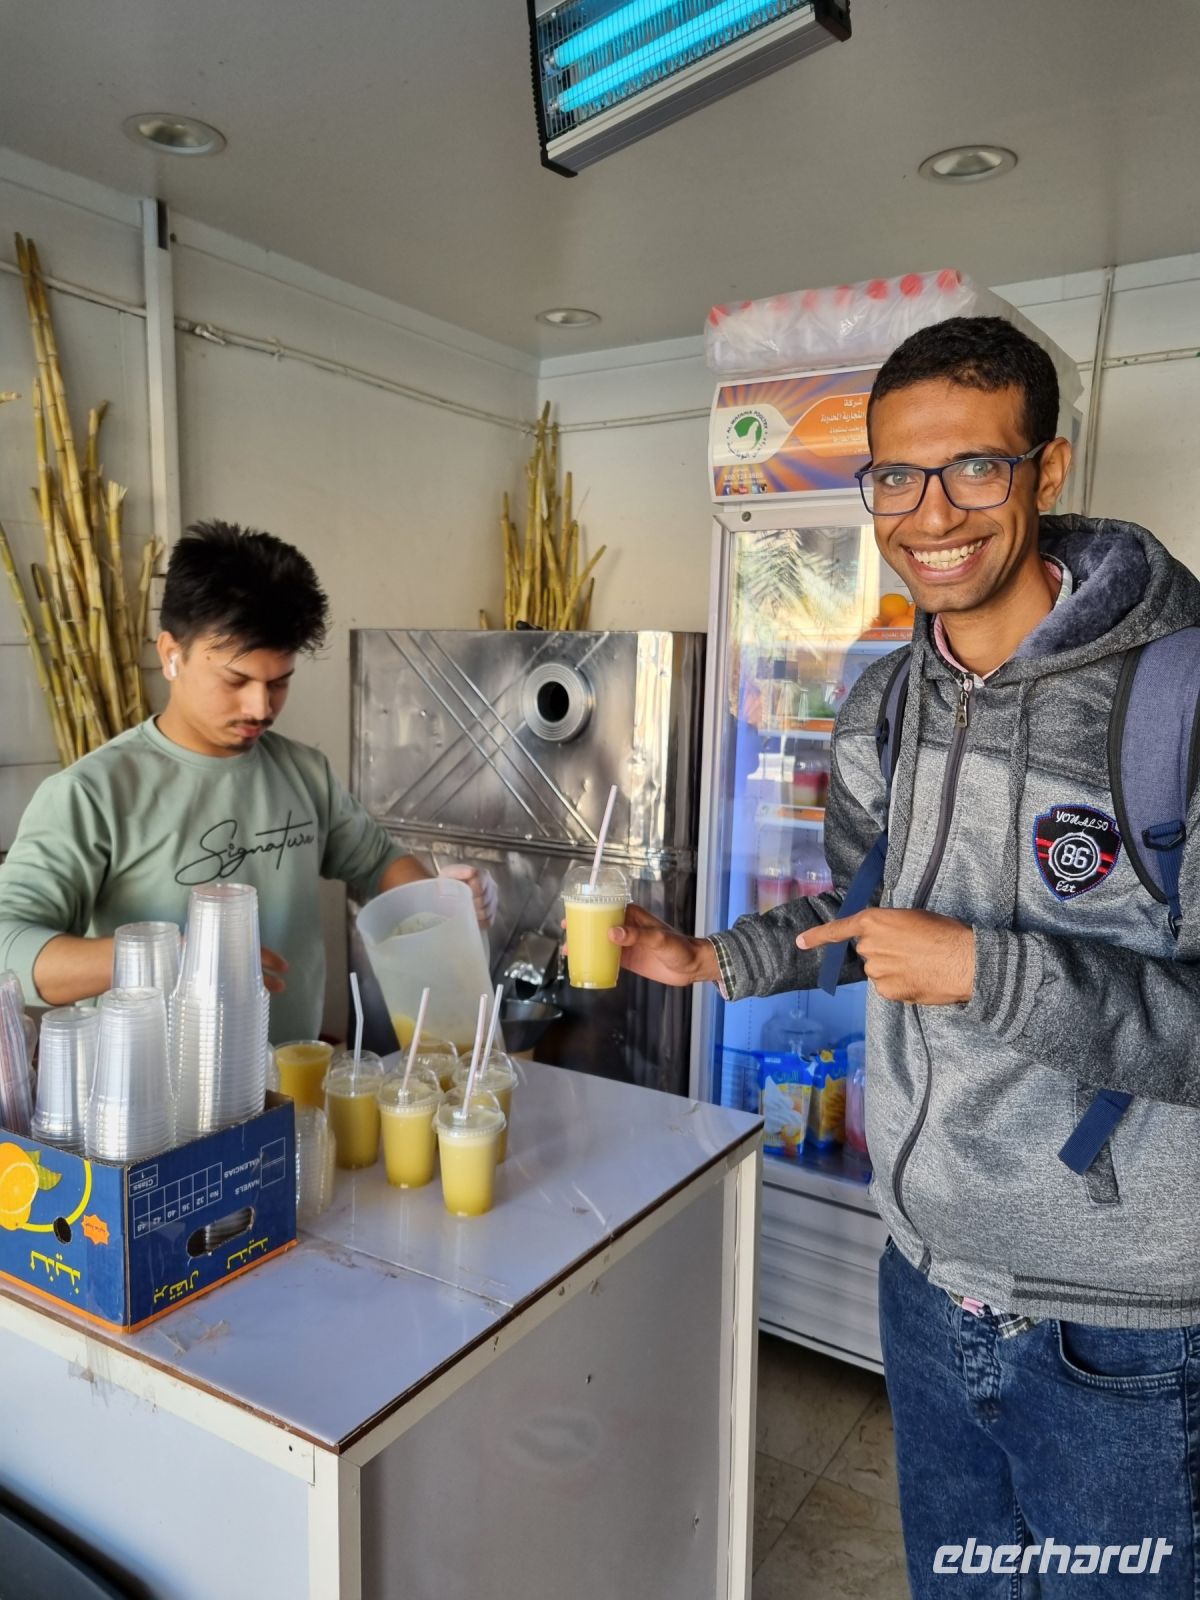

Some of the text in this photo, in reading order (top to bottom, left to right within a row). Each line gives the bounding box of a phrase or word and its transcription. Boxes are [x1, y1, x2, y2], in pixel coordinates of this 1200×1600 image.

[175, 810, 315, 886] Signature
[1061, 844, 1091, 868] 86
[133, 1178, 154, 1191] Class
[235, 1179, 260, 1196] NAVELS
[182, 1202, 191, 1212] 36
[196, 1195, 205, 1205] 32
[153, 1216, 162, 1225] 42
[167, 1209, 177, 1218] 40
[31, 1250, 81, 1294] لذيذ
[153, 1237, 269, 1304] برتقال لذيذ
